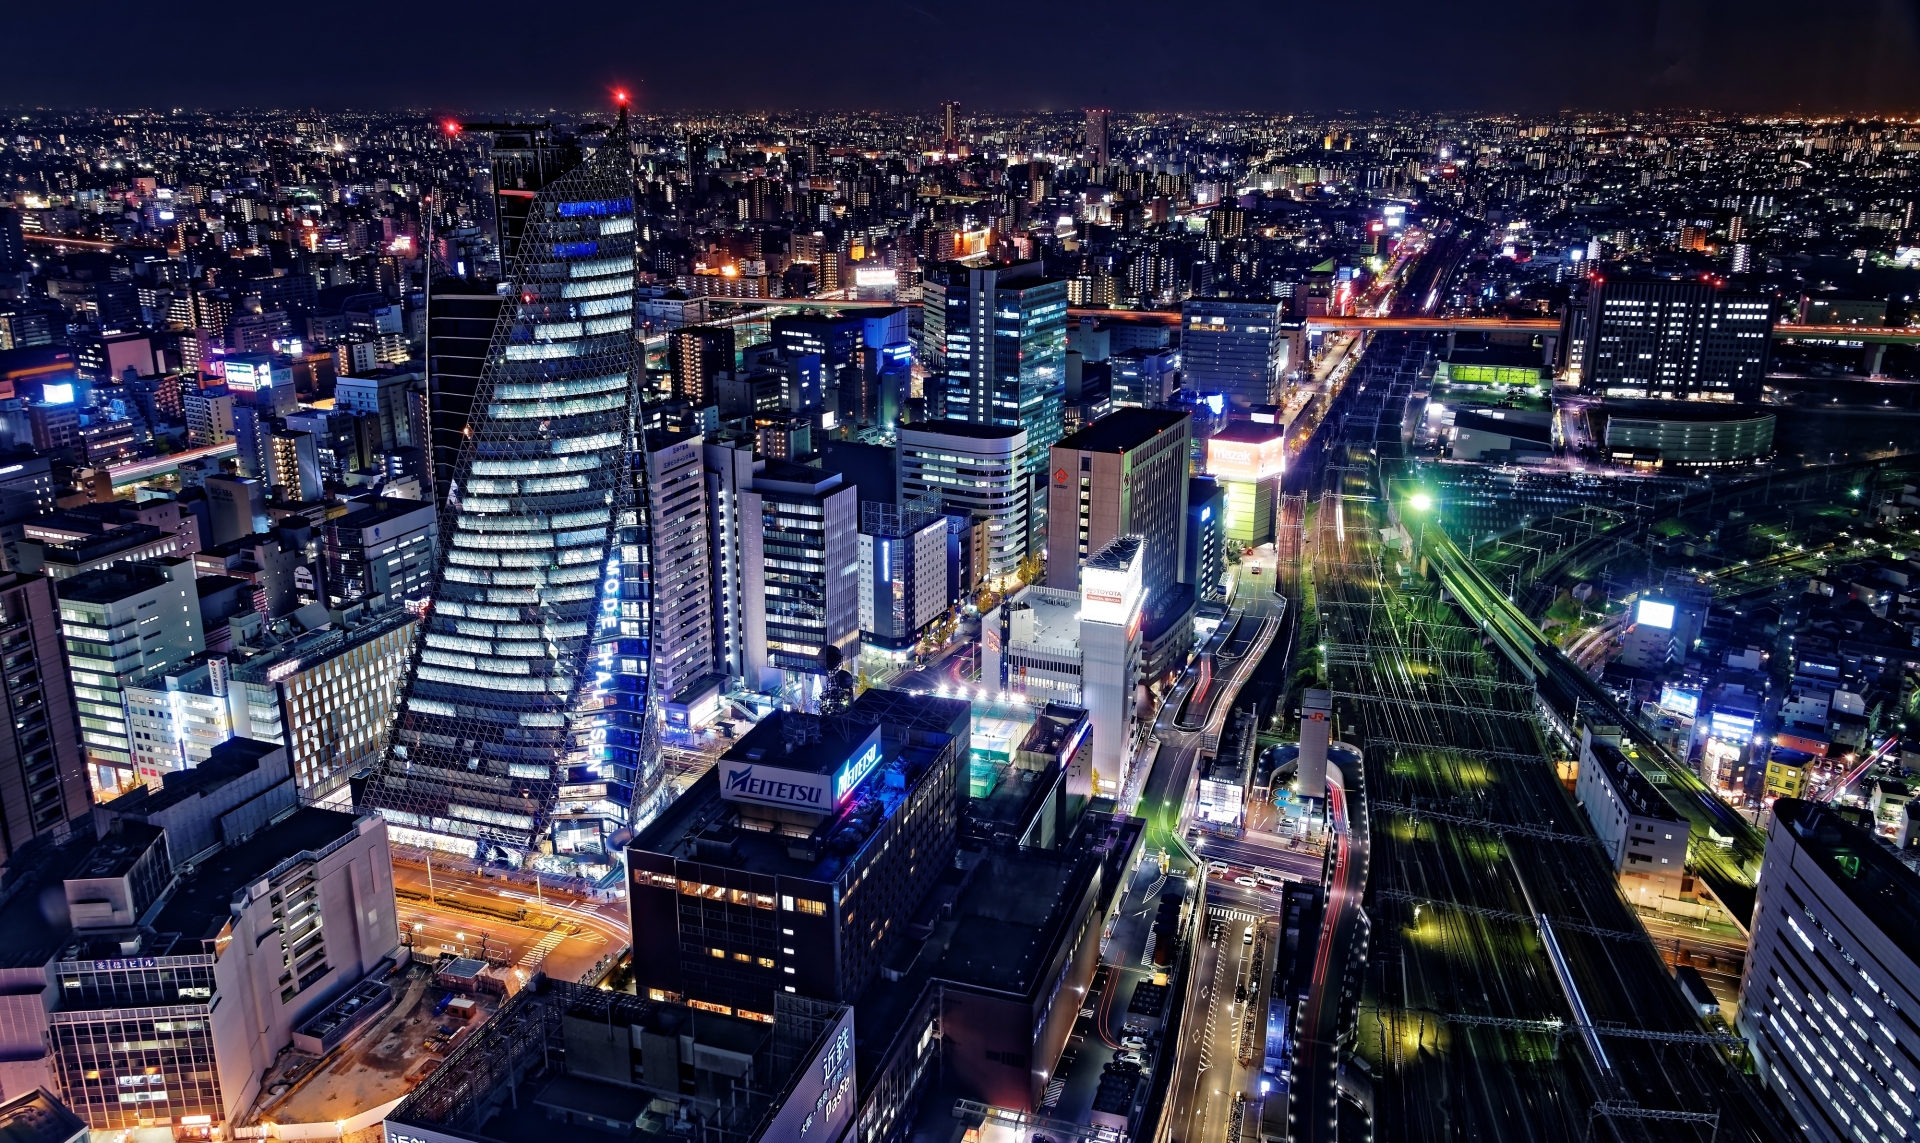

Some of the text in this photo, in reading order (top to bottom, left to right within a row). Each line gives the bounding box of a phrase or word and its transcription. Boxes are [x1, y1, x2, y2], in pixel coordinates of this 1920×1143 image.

[1213, 447, 1252, 462] Mazak
[601, 559, 620, 630] MODE
[1096, 589, 1122, 597] TOYOTA
[593, 652, 613, 705] HAL
[1309, 712, 1324, 721] JR
[725, 765, 822, 804] MEITETSU
[837, 743, 877, 800] MEITETSU
[823, 1026, 849, 1086] 近鉄
